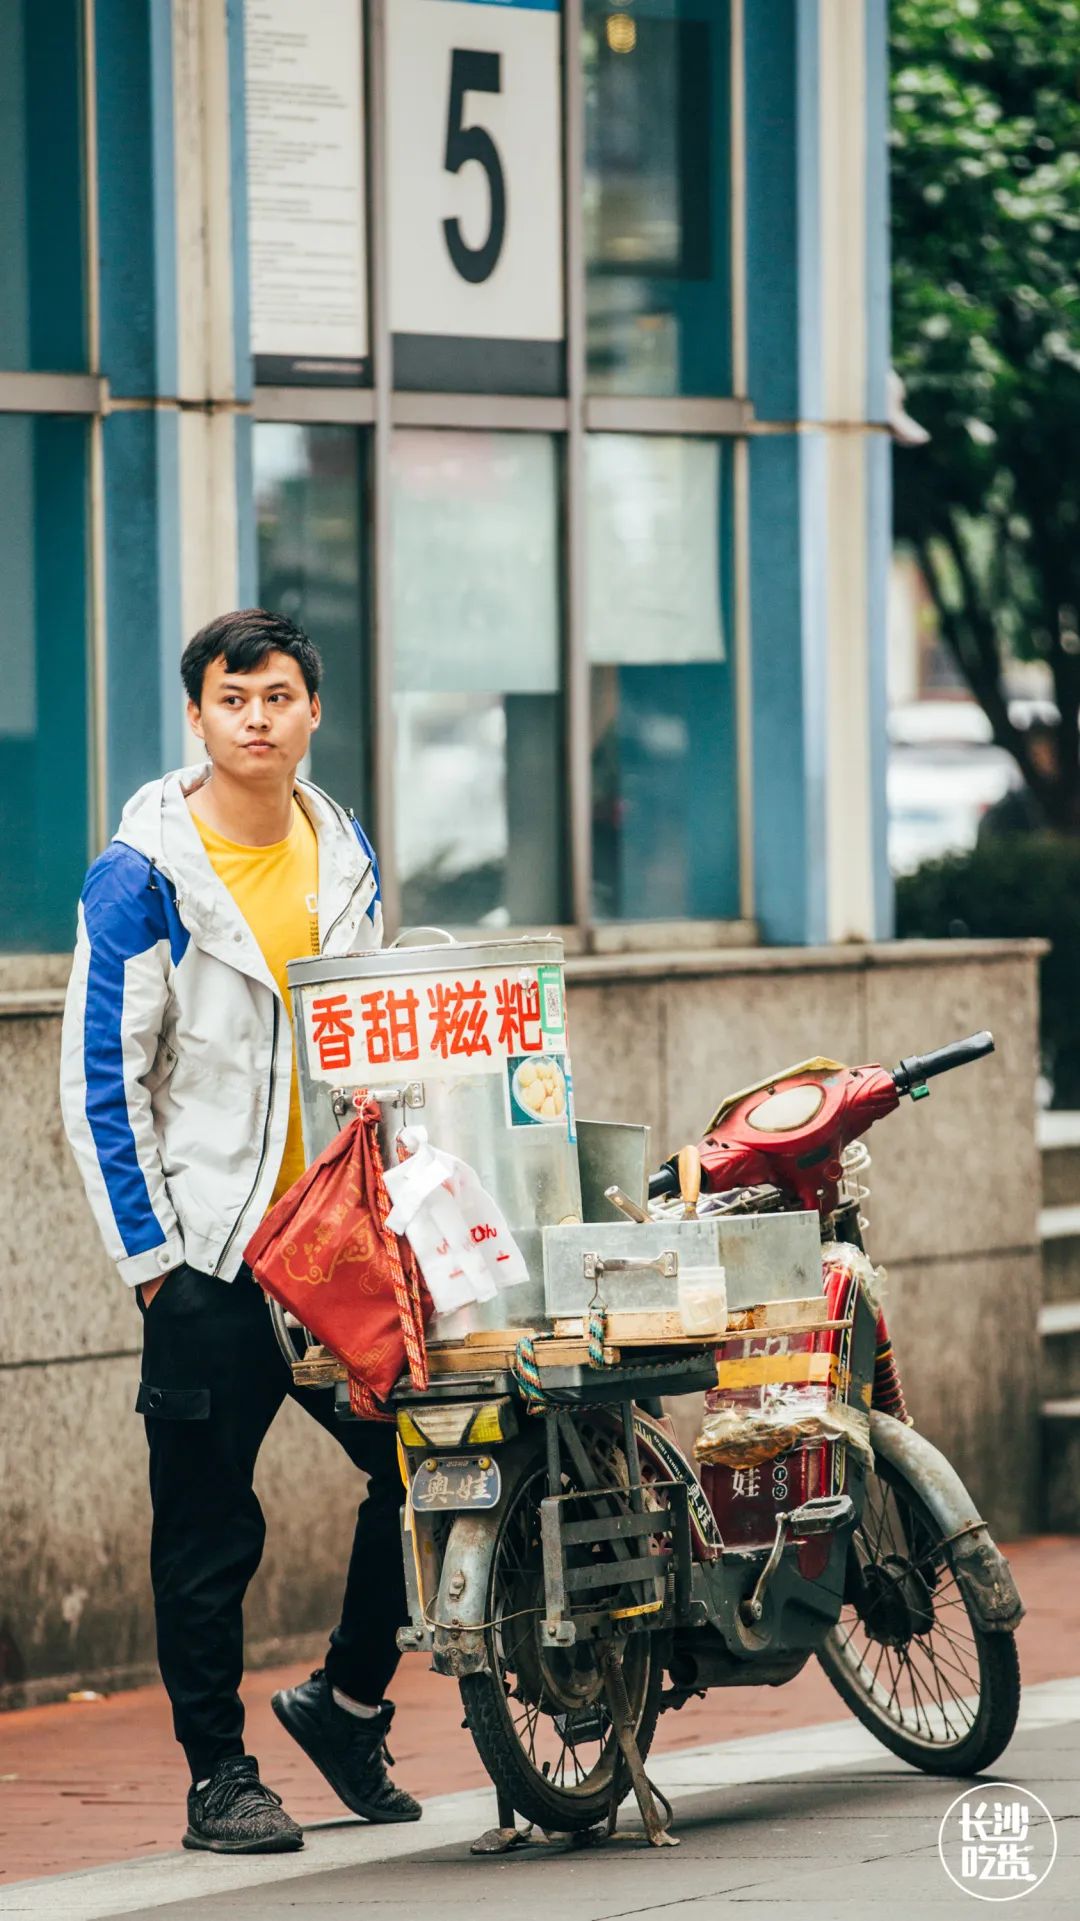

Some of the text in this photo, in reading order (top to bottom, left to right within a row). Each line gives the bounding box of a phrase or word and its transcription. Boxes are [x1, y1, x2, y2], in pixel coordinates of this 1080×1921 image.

[442, 48, 507, 284] 5
[311, 978, 543, 1071] 香甜糍粑
[418, 1470, 492, 1504] 奥娃
